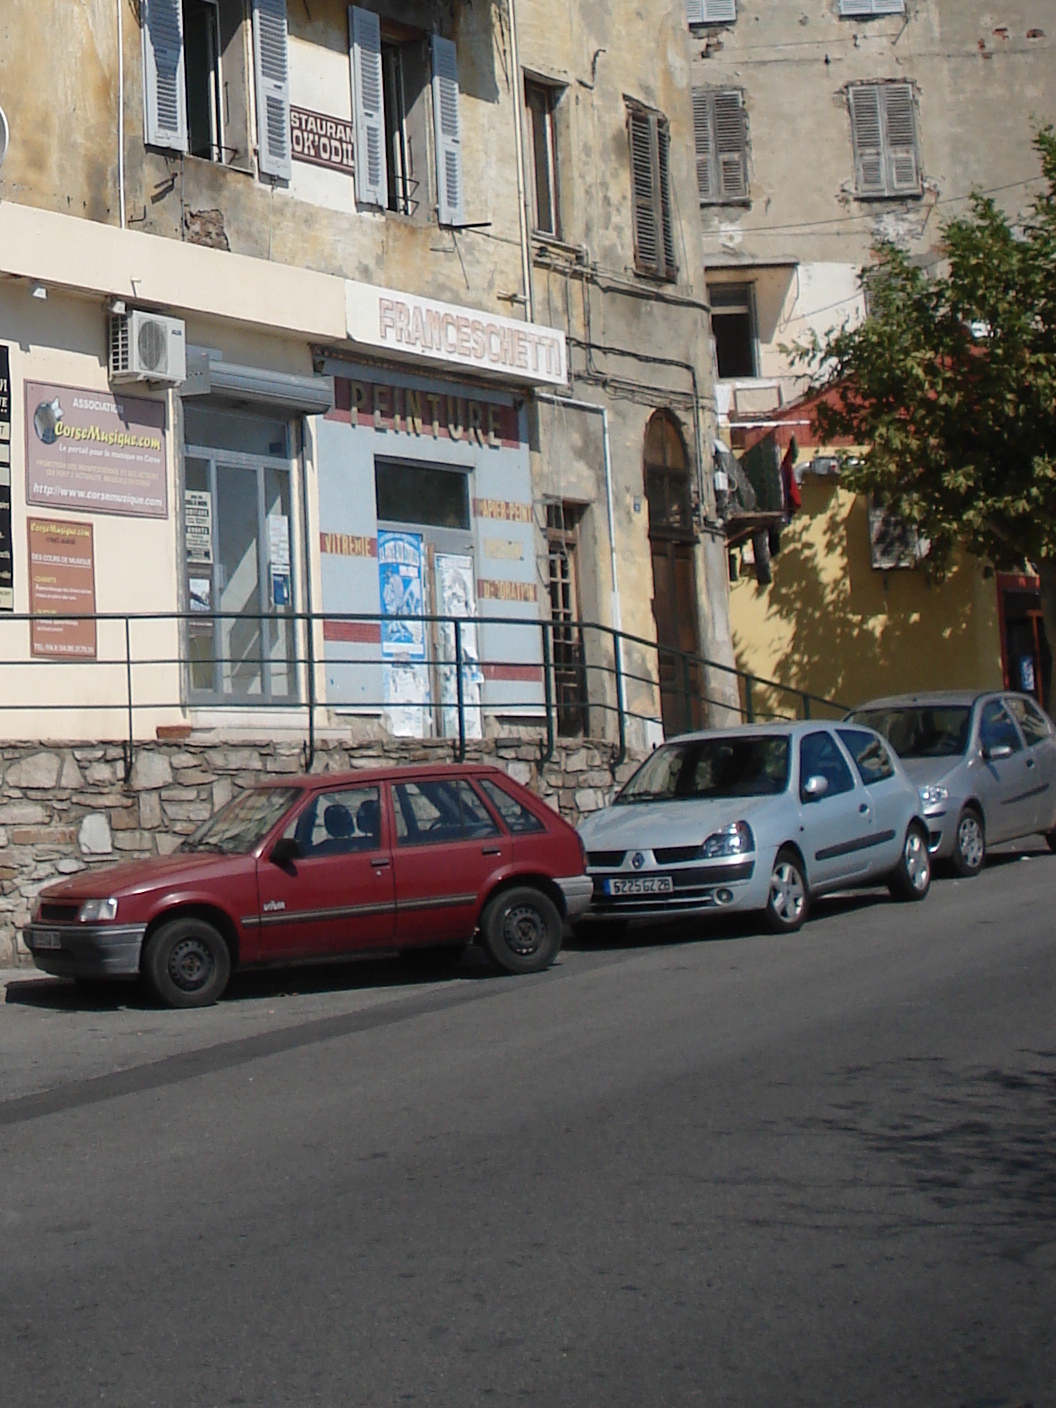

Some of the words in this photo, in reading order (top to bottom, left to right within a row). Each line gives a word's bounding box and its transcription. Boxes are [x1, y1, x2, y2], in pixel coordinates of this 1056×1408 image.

[378, 297, 562, 376] FRANCESCHETTI
[55, 421, 162, 451] CorseMusique.com
[350, 380, 502, 448] PEINTURE
